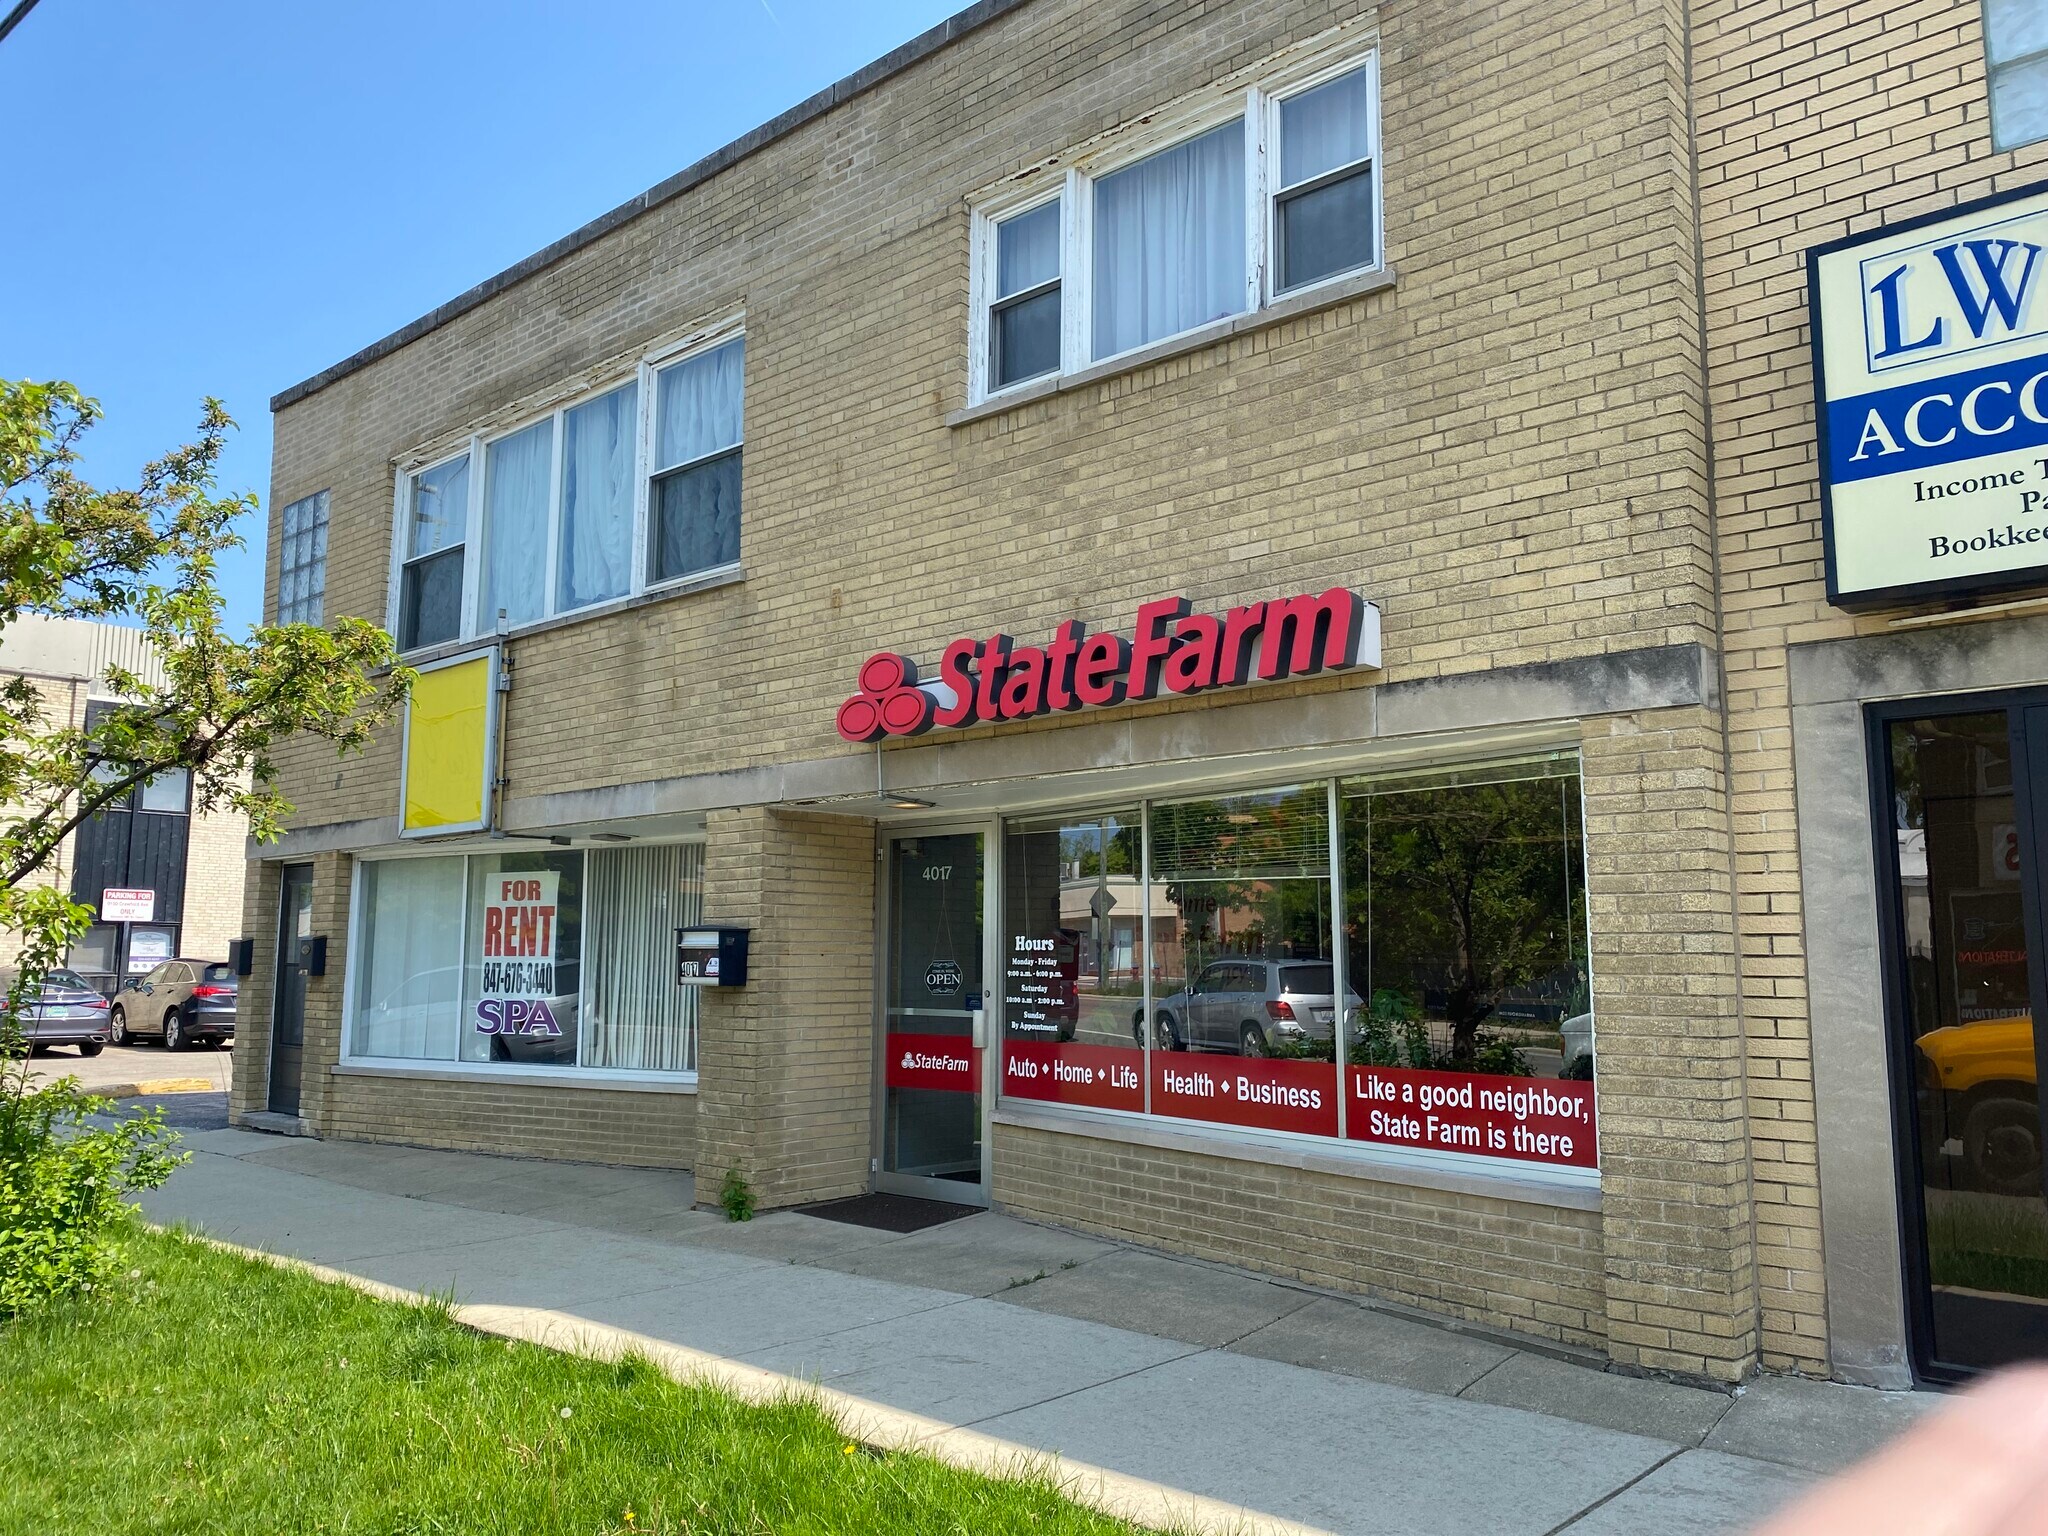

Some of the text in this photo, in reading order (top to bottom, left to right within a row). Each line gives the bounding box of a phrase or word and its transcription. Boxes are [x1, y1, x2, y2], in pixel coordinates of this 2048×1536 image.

[1914, 469, 2025, 502] Income
[922, 865, 952, 881] 4017
[107, 891, 151, 900] PARKING FOR
[501, 879, 541, 902] FOR
[484, 905, 556, 957] RENT
[1015, 936, 1055, 951] Hours
[1012, 958, 1034, 966] Monday
[1038, 958, 1057, 966] Friday
[483, 962, 553, 994] 847-676-3440
[927, 973, 960, 985] OPEN
[1021, 984, 1048, 993] Saturday
[476, 998, 562, 1036] SPA
[1011, 1021, 1058, 1031] By Appointment
[1023, 1011, 1045, 1020] Sunday
[1008, 1055, 1138, 1089] Auto Home Life
[1164, 1069, 1322, 1110] Health Business
[1355, 1074, 1589, 1124] Like a good neighbor,
[1370, 1110, 1574, 1157] State Farm is there
